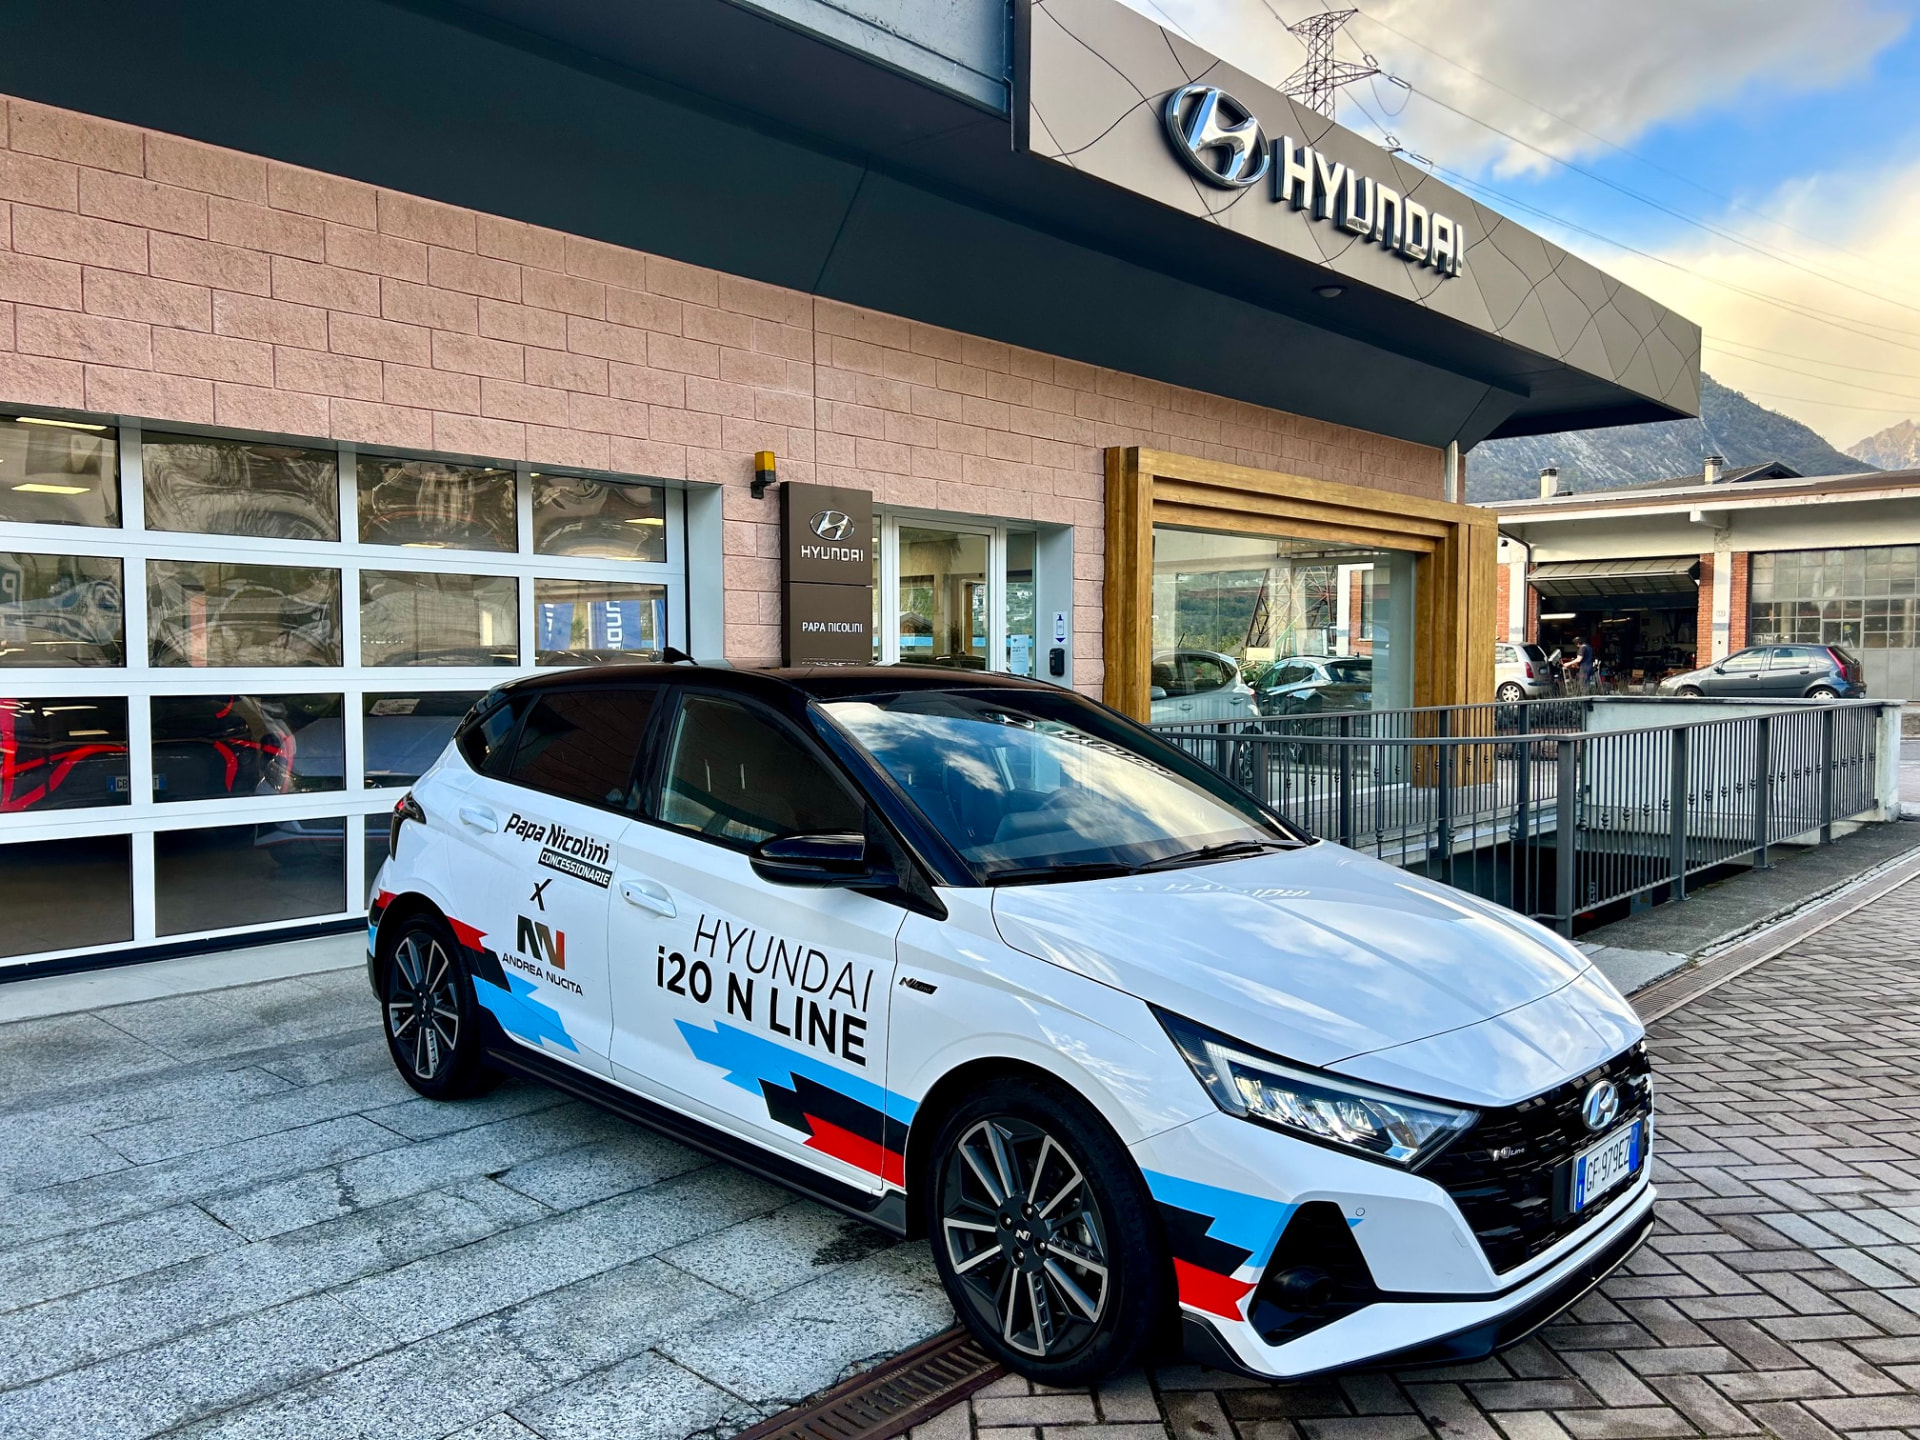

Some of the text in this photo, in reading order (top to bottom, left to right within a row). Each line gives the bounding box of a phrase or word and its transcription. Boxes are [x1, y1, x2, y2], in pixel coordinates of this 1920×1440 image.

[1278, 135, 1464, 277] HYUNDAI
[801, 545, 864, 562] HYUNDAI
[802, 622, 863, 633] PAPA NICOLINI
[504, 813, 610, 865] Papa Nicolini
[540, 851, 611, 886] CONCESSIONARIE
[502, 953, 583, 997] ANDREA NUCITA
[694, 914, 874, 1013] HYUNDAI
[657, 945, 867, 1067] i20 N LINE
